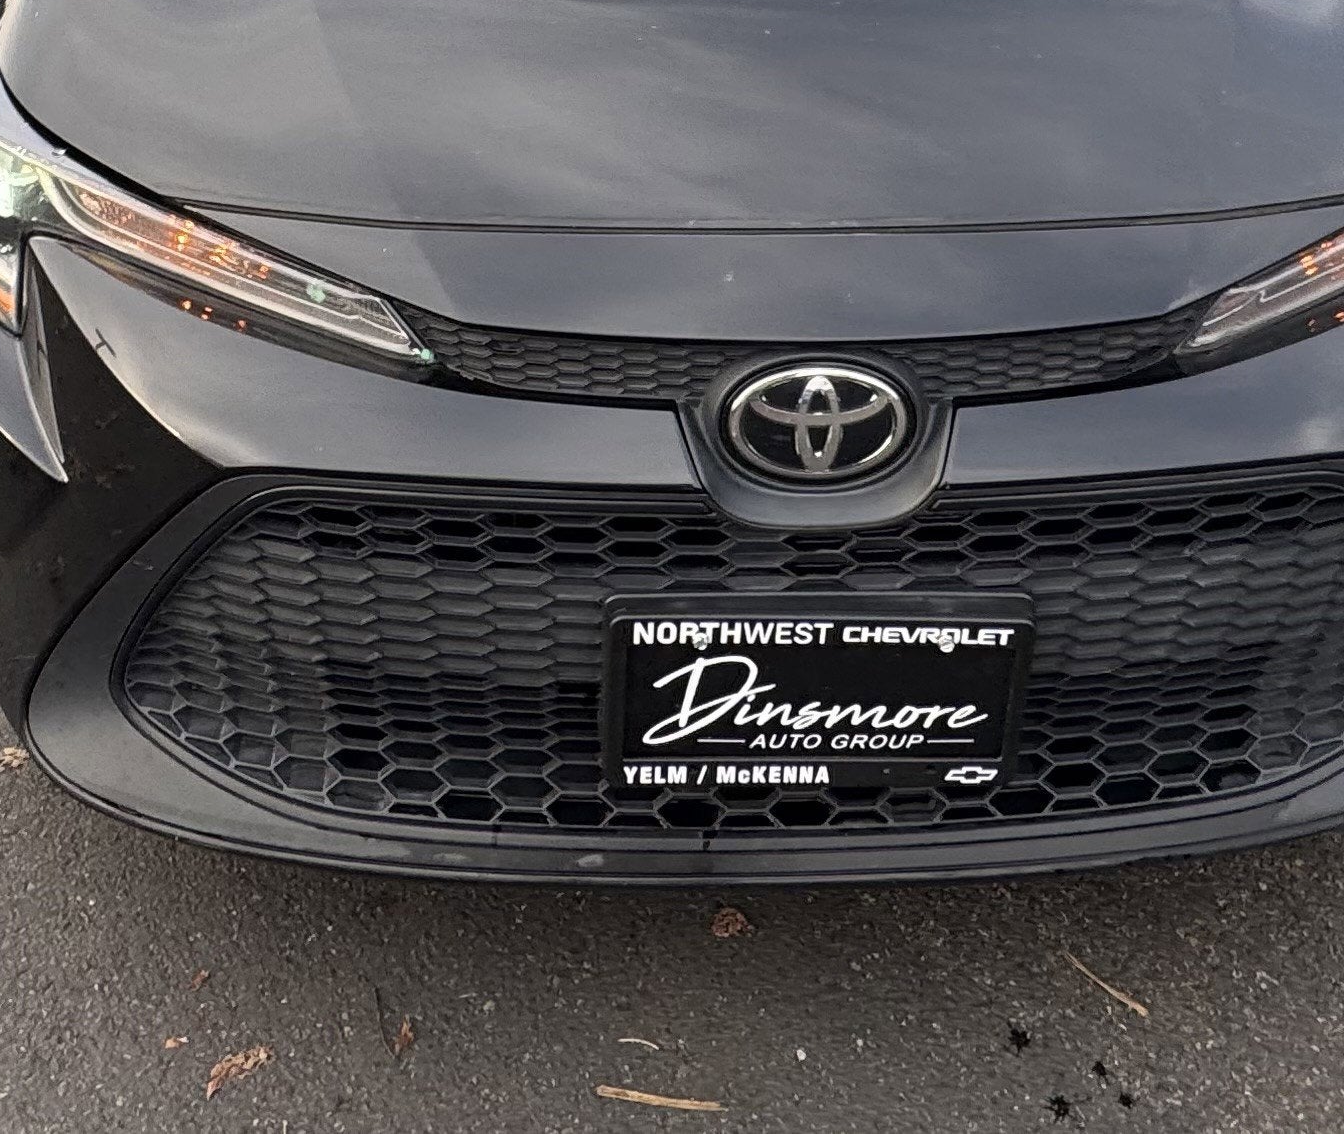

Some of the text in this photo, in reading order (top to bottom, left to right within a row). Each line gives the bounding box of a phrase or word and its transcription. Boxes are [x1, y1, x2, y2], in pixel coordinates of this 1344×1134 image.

[632, 621, 1015, 646] NORTHWEST CHEVROLET
[642, 655, 989, 745] Dinsmore
[748, 733, 925, 750] AUTO GROUP
[623, 765, 830, 785] YELM / McKENNA
